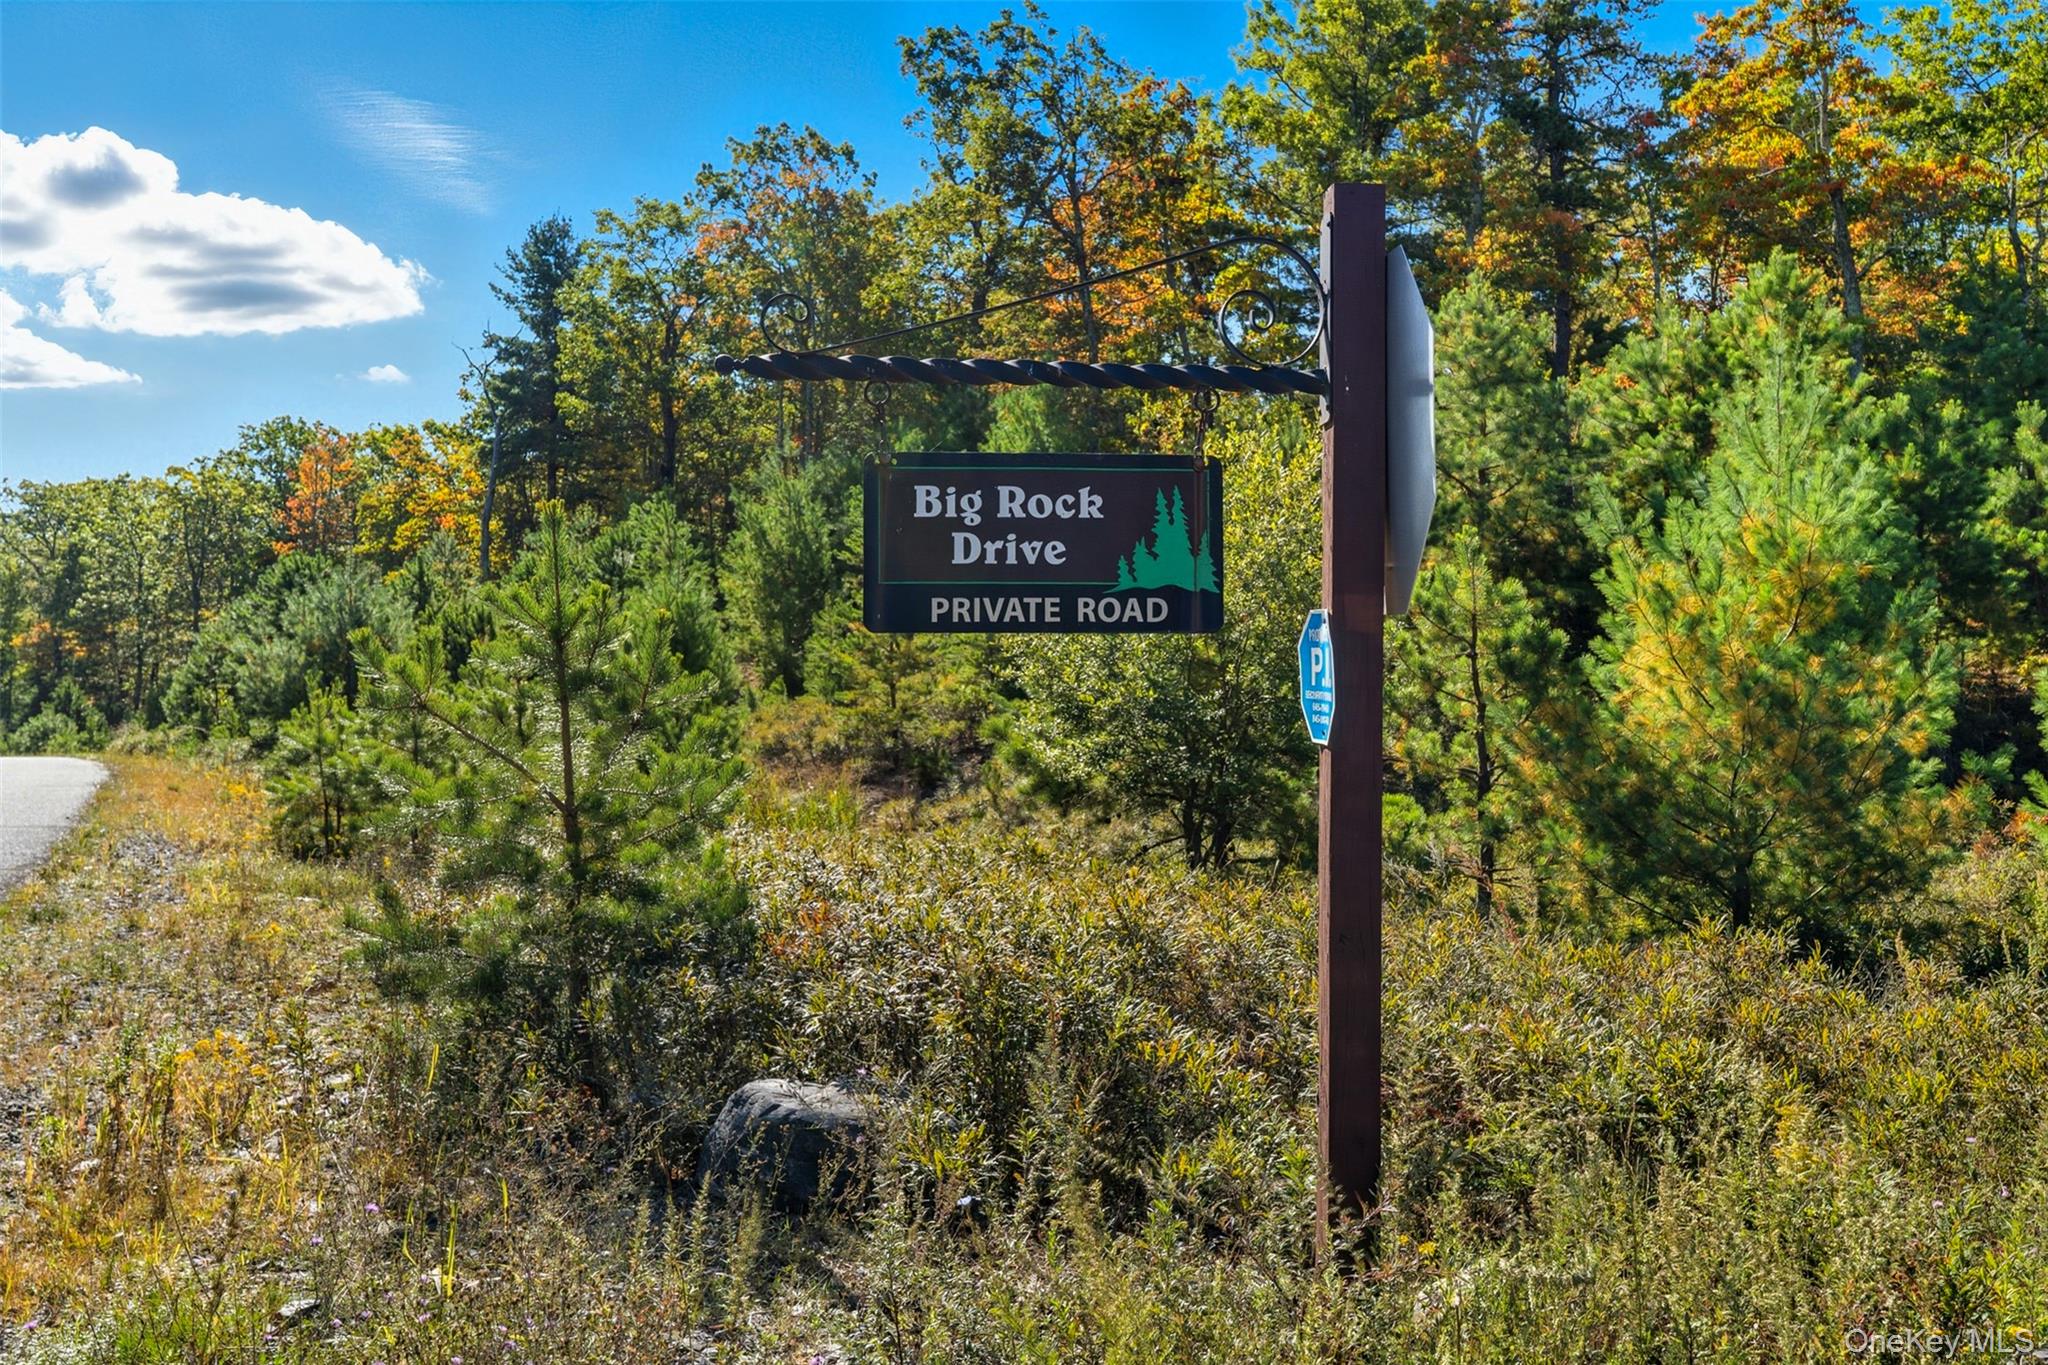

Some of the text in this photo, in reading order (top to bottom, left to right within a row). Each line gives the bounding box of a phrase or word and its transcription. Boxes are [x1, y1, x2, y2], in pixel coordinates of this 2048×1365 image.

[913, 484, 1104, 526] Big Rock
[951, 531, 1067, 566] Drive
[930, 596, 1169, 623] PRIVATE ROAD
